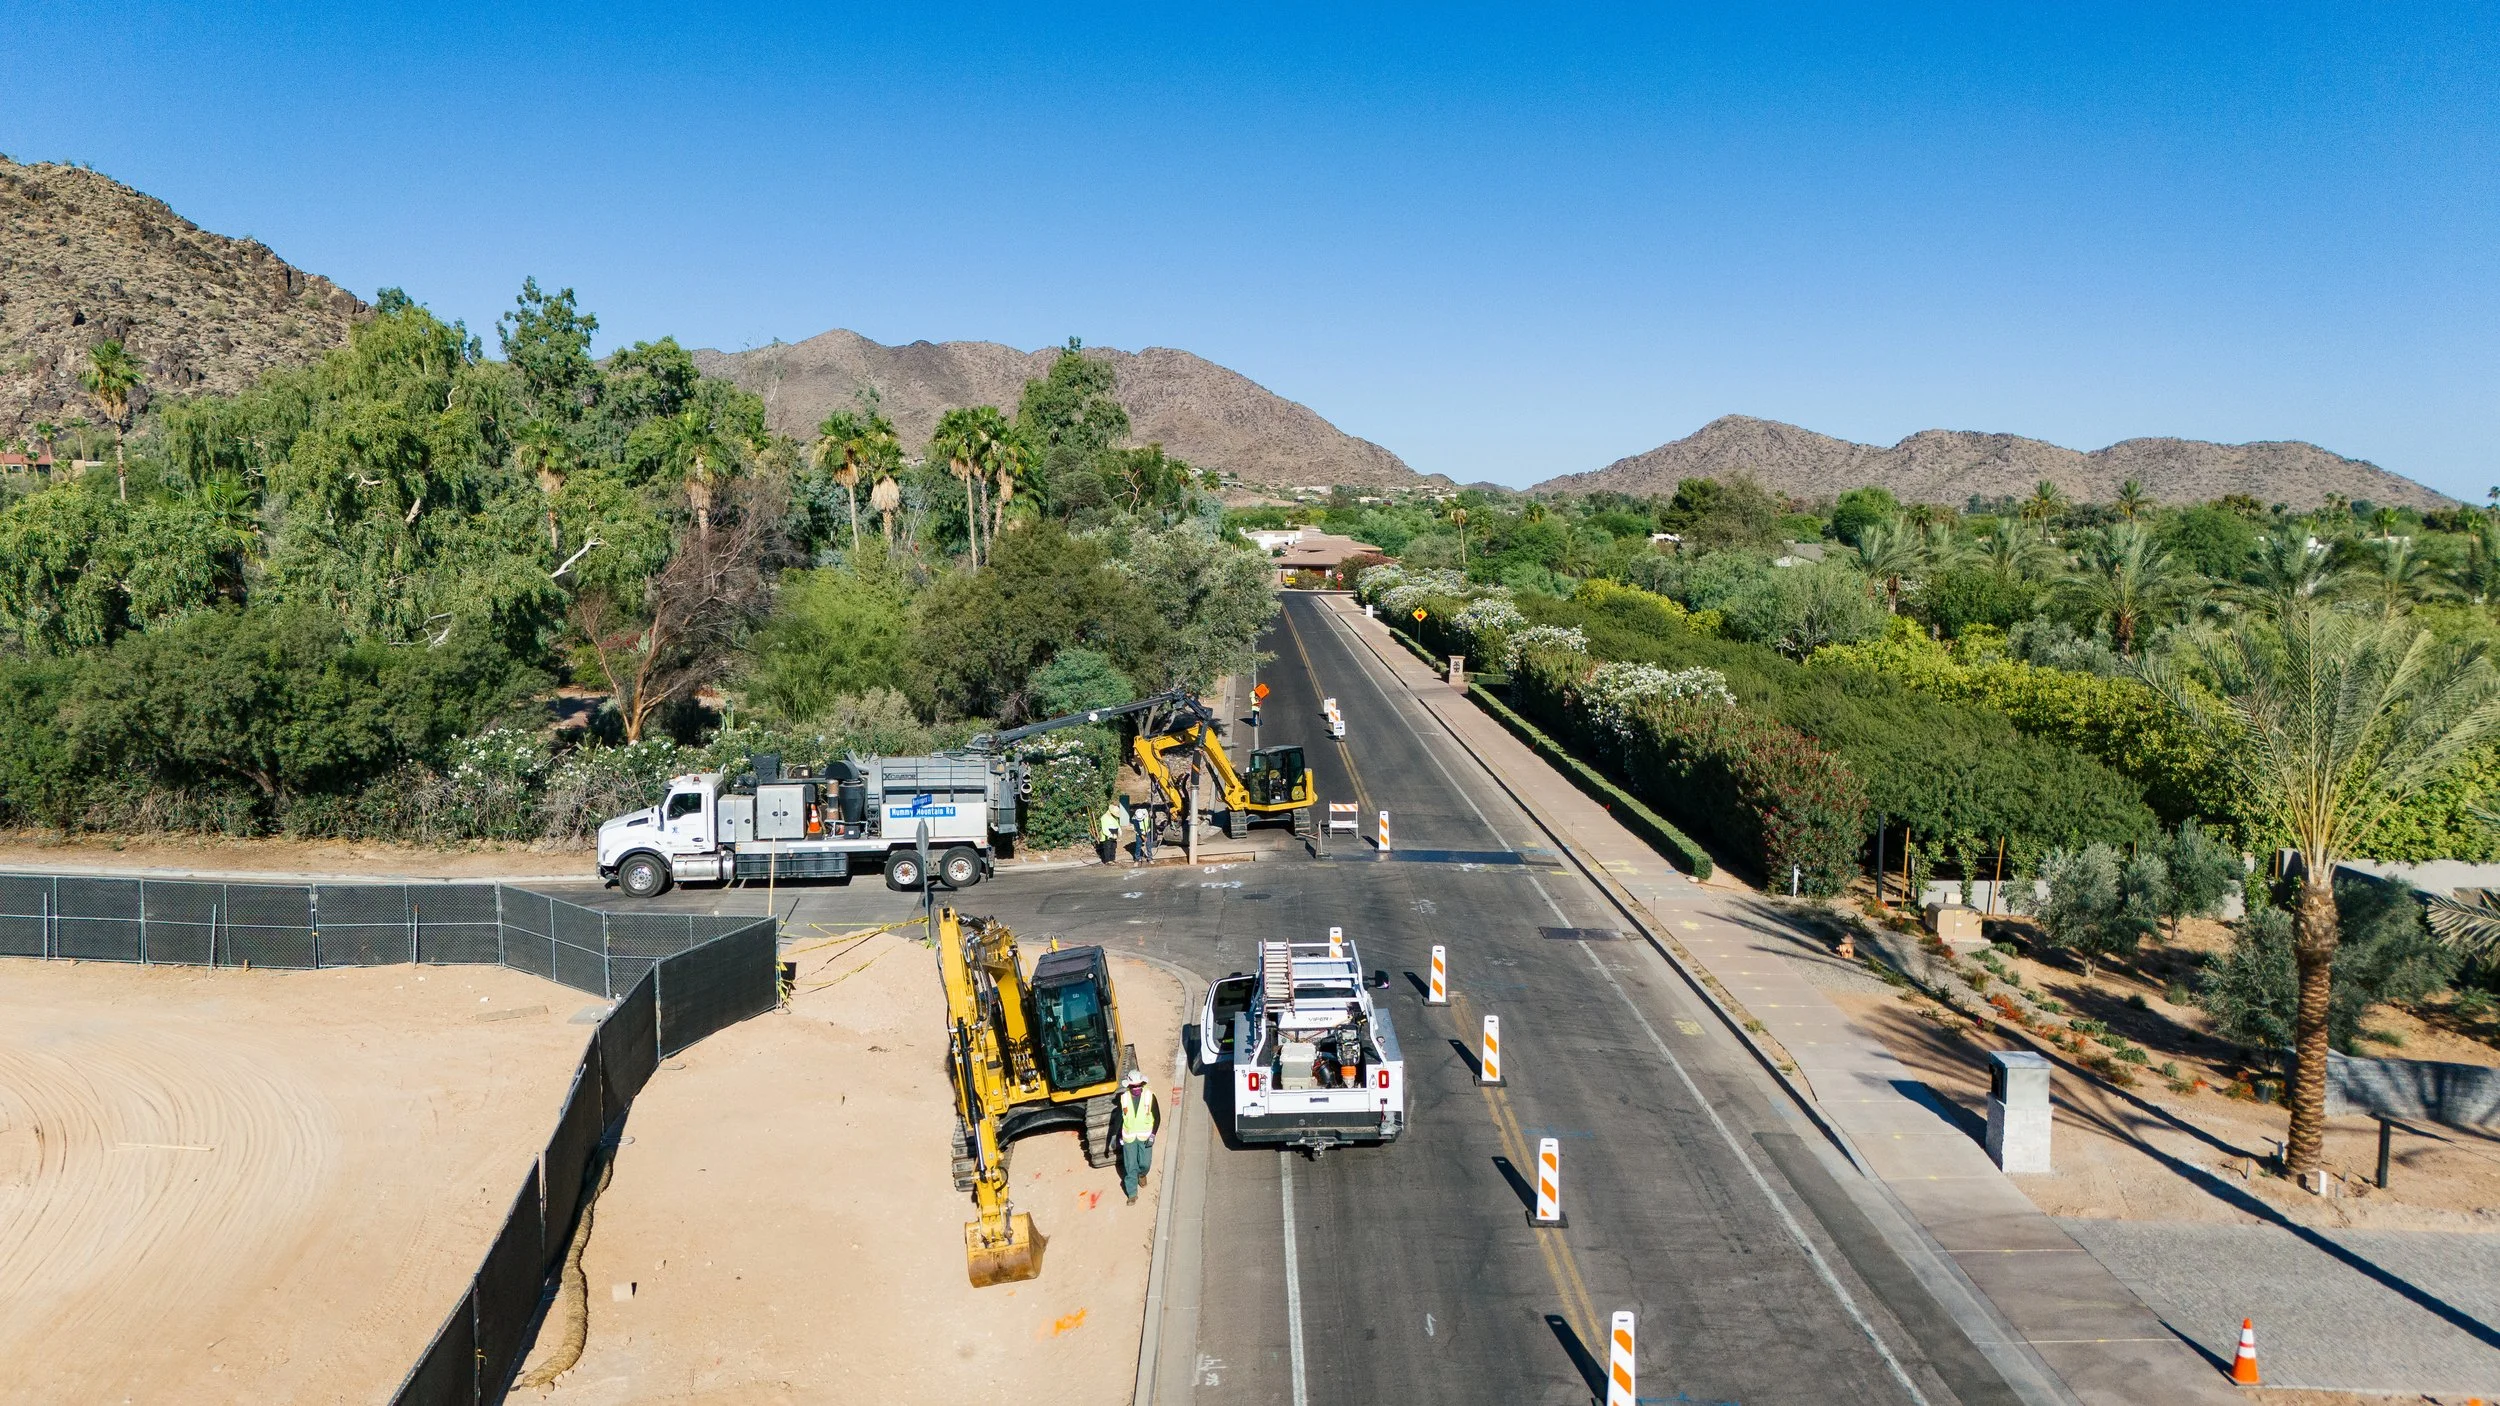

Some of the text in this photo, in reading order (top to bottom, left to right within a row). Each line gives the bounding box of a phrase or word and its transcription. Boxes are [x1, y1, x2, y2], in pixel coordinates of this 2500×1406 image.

[891, 806, 954, 817] Mummy Mountain Rd
